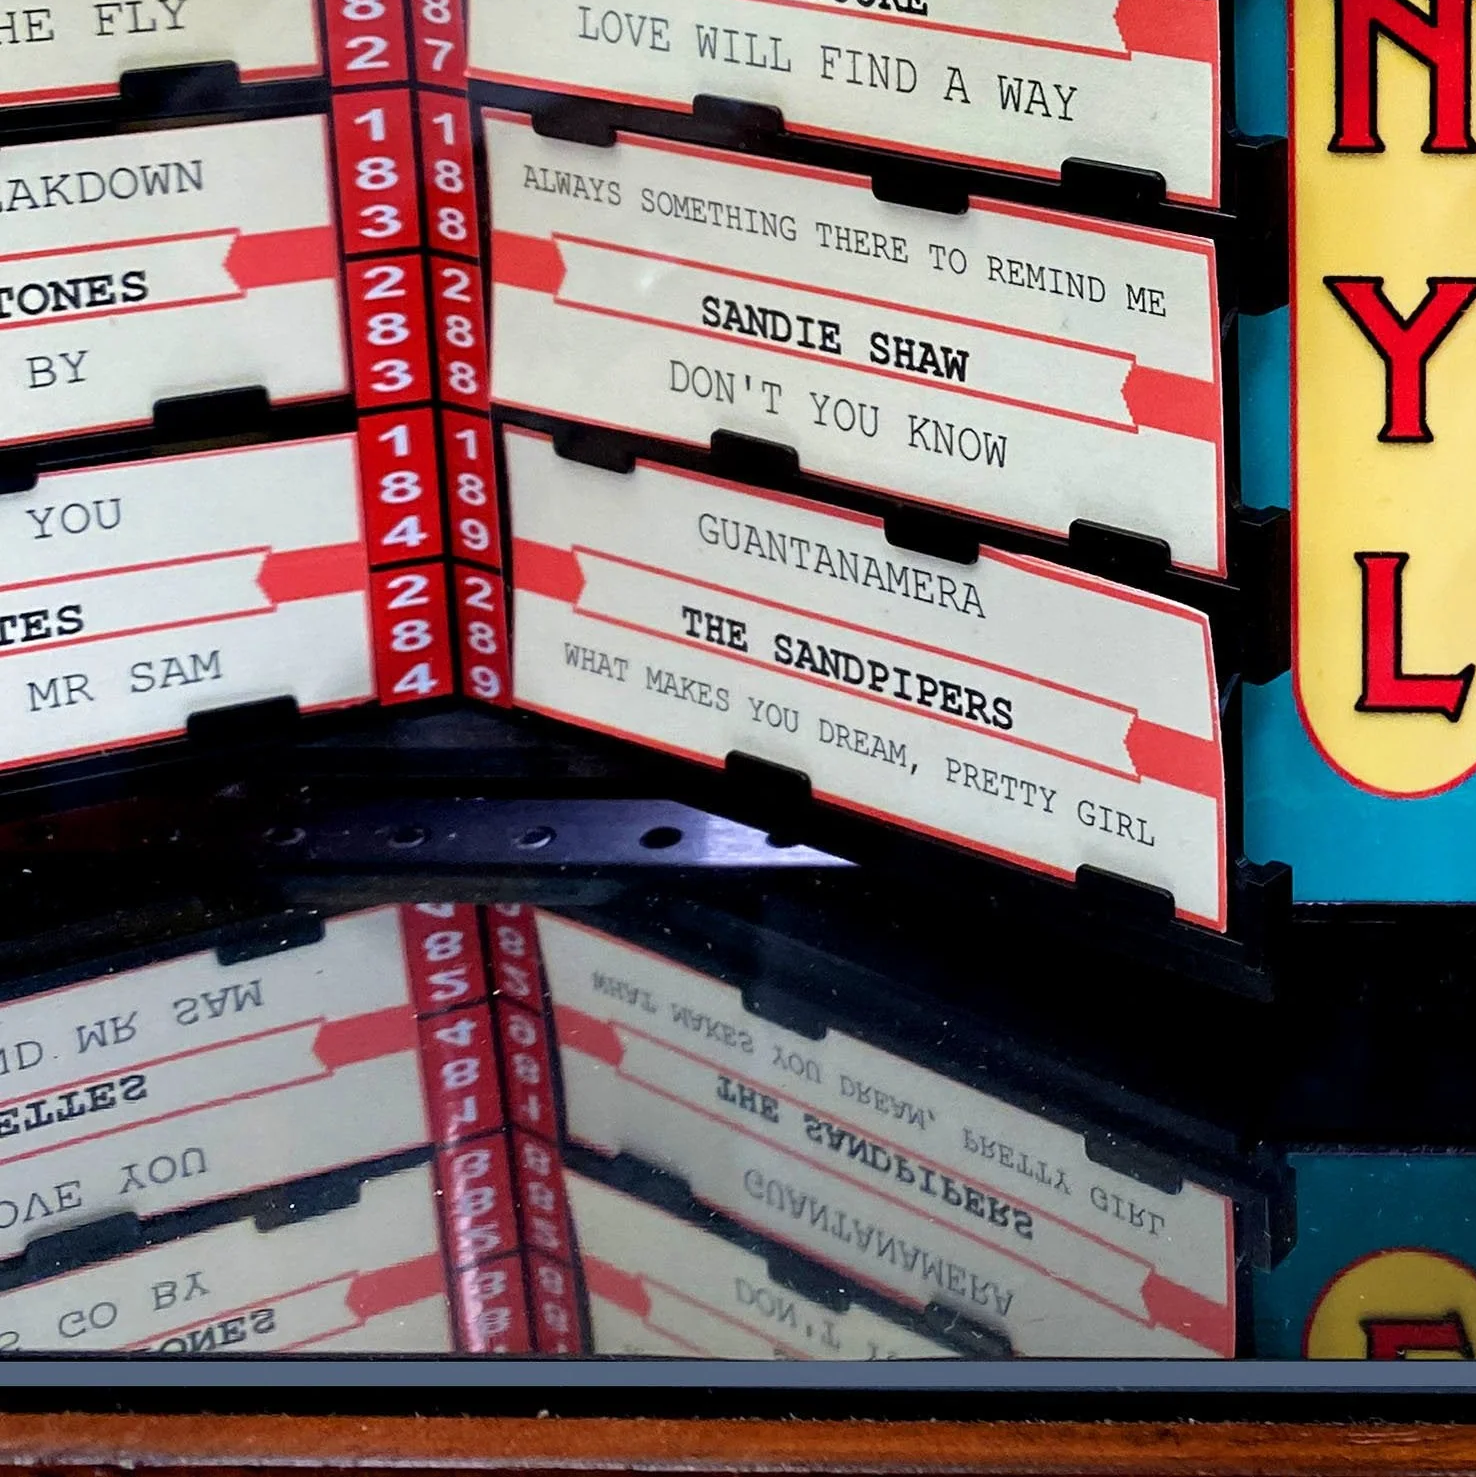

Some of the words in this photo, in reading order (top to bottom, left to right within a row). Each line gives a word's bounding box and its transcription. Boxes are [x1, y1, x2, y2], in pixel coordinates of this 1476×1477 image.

[578, 5, 670, 53] LOVE
[695, 24, 792, 73] WILL
[820, 45, 918, 94] FIND
[943, 66, 971, 105] A
[997, 74, 1078, 122] WAY
[0, 159, 202, 213] AKDOWN
[354, 108, 402, 238] 183
[432, 112, 467, 241] 188
[523, 164, 622, 206] ALWAYS
[641, 187, 797, 242] SOMETHING
[815, 221, 909, 264] THERE
[928, 243, 967, 275] TO
[986, 255, 1106, 303] REMIND
[1125, 283, 1166, 318] ME
[25, 350, 88, 389] BY
[363, 265, 413, 392] 283
[442, 267, 478, 394] 288
[702, 295, 842, 356] SANDIE
[869, 331, 970, 383] SHAW
[669, 359, 782, 415] DON'T
[809, 391, 880, 438] YOU
[907, 414, 1008, 469] KNOW
[25, 498, 121, 540] YOU
[379, 424, 428, 547] 184
[455, 429, 489, 551] 189
[699, 513, 986, 619] GUANTANAMERA
[26, 673, 94, 712] MR
[130, 649, 222, 693] SAM
[387, 574, 438, 694] 284
[465, 576, 500, 698] 289
[681, 605, 749, 653] THE
[769, 633, 1013, 733] SANDPIPERS
[563, 642, 629, 683] WHAT
[646, 666, 730, 712] MAKES
[747, 696, 799, 734] YOU
[818, 718, 918, 776] DREAM,
[945, 756, 1057, 814] PRETTY
[1077, 799, 1155, 847] GIRL
